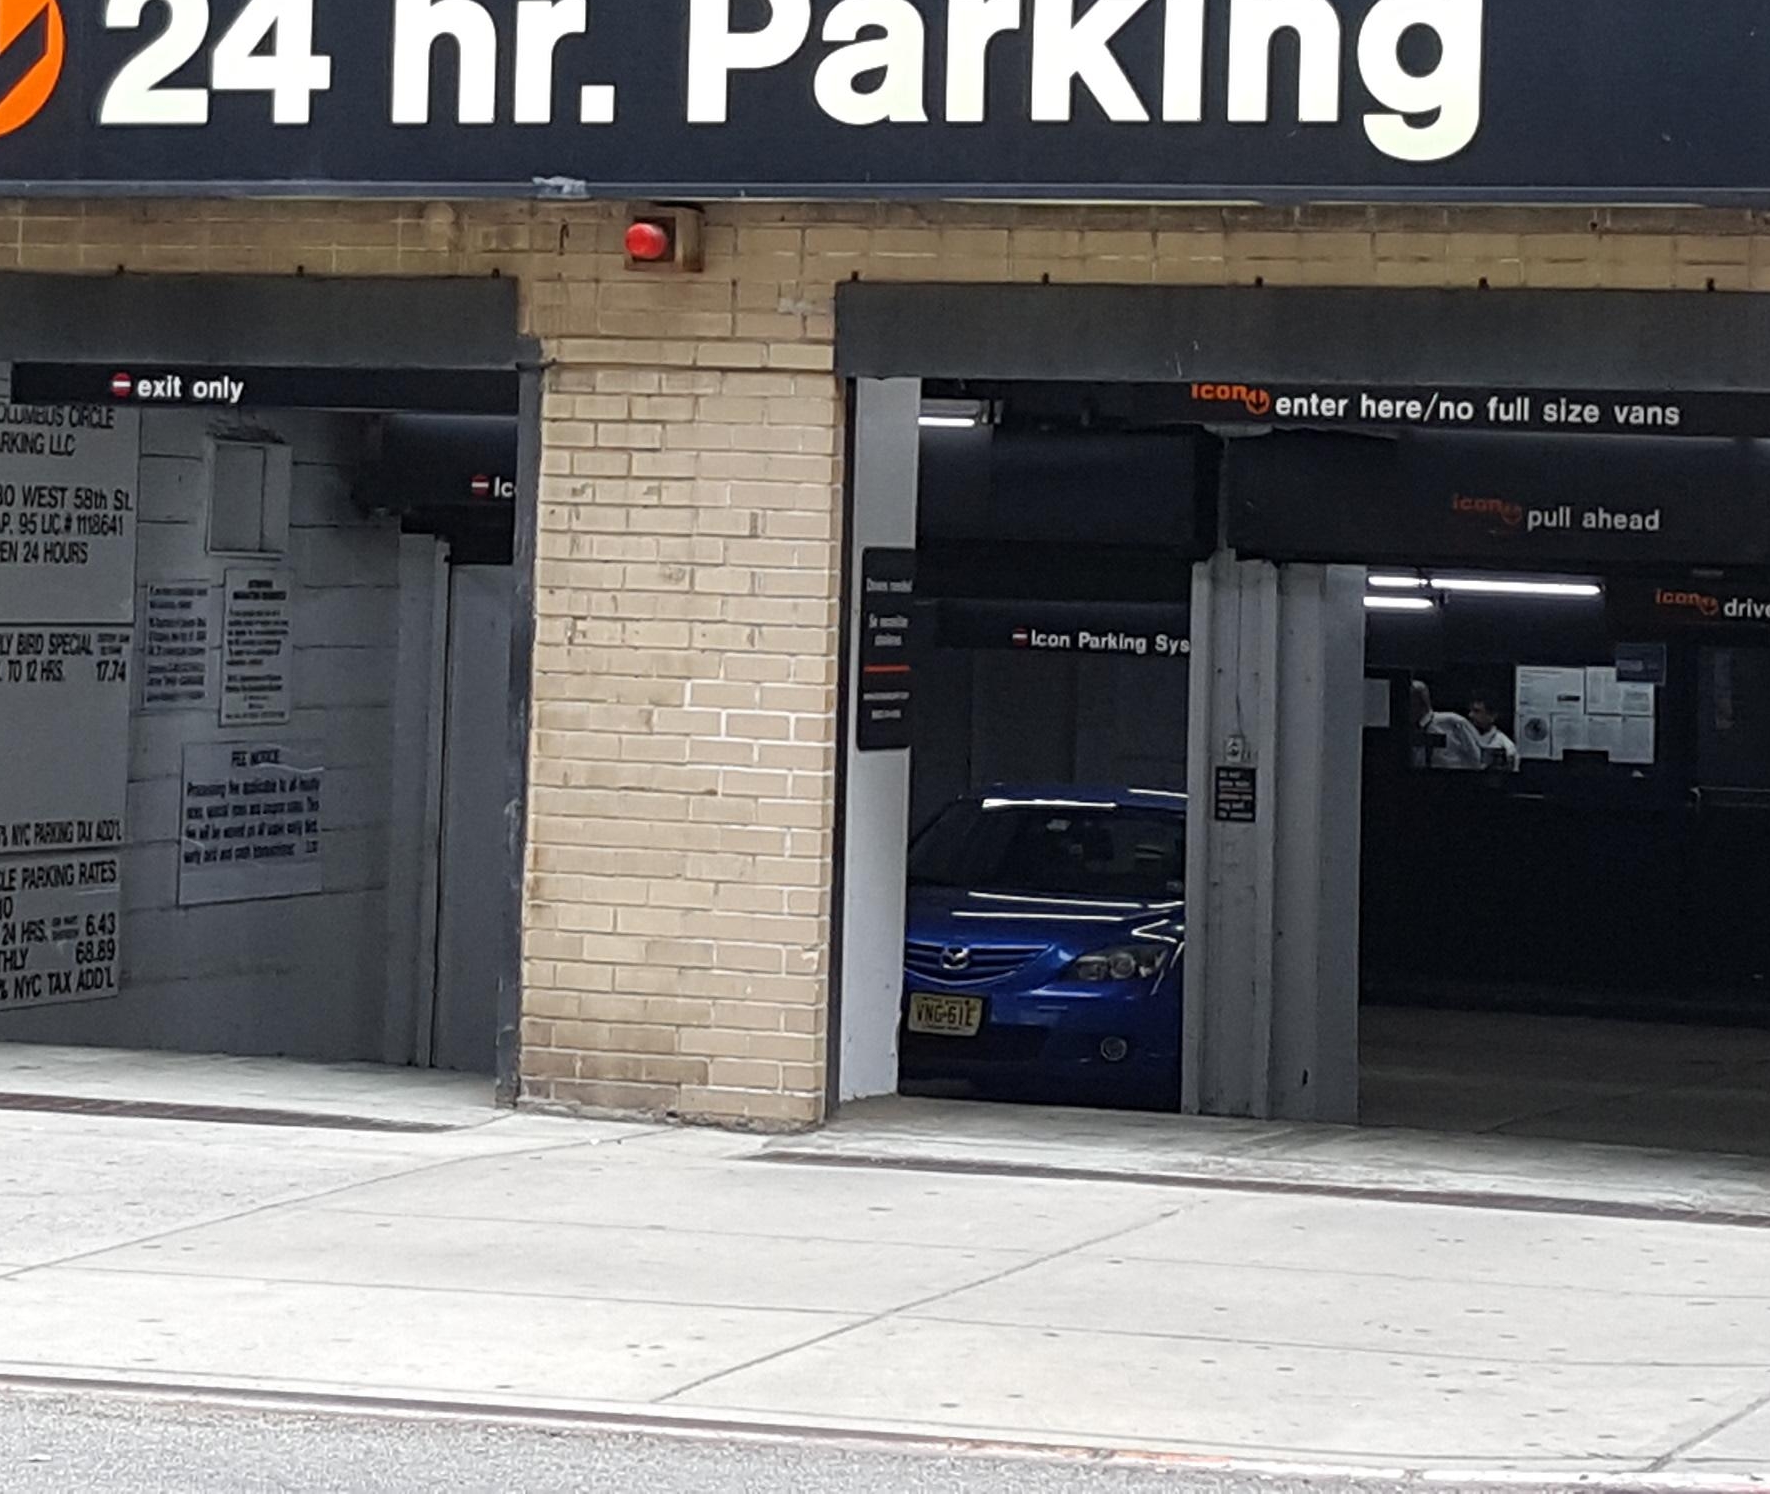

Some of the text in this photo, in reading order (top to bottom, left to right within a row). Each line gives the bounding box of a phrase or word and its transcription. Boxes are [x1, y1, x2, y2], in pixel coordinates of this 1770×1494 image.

[137, 374, 244, 404] exit only
[1191, 383, 1247, 400] icon
[1275, 392, 1348, 417] enter
[1487, 396, 1529, 422] full
[1543, 397, 1600, 423] size
[1614, 404, 1680, 425] vans
[49, 433, 76, 456] LLC
[22, 485, 68, 509] WEST
[74, 488, 108, 511] 58th
[19, 512, 37, 535] 95
[1527, 506, 1571, 532] pull
[1582, 507, 1660, 531] ahead
[23, 541, 39, 563] 24
[43, 541, 88, 564] HOURS
[1655, 588, 1701, 606] icon
[16, 633, 44, 655] BIRD
[48, 633, 94, 655] SPECIAL
[1031, 629, 1070, 648] Icon
[1079, 631, 1147, 654] Parking
[8, 659, 22, 683] TO
[21, 864, 74, 890] PARKING
[80, 860, 117, 884] RATES
[2, 923, 16, 946] 24
[85, 912, 116, 937] 6.43
[14, 974, 42, 1000] NYC
[48, 971, 72, 996] TAX
